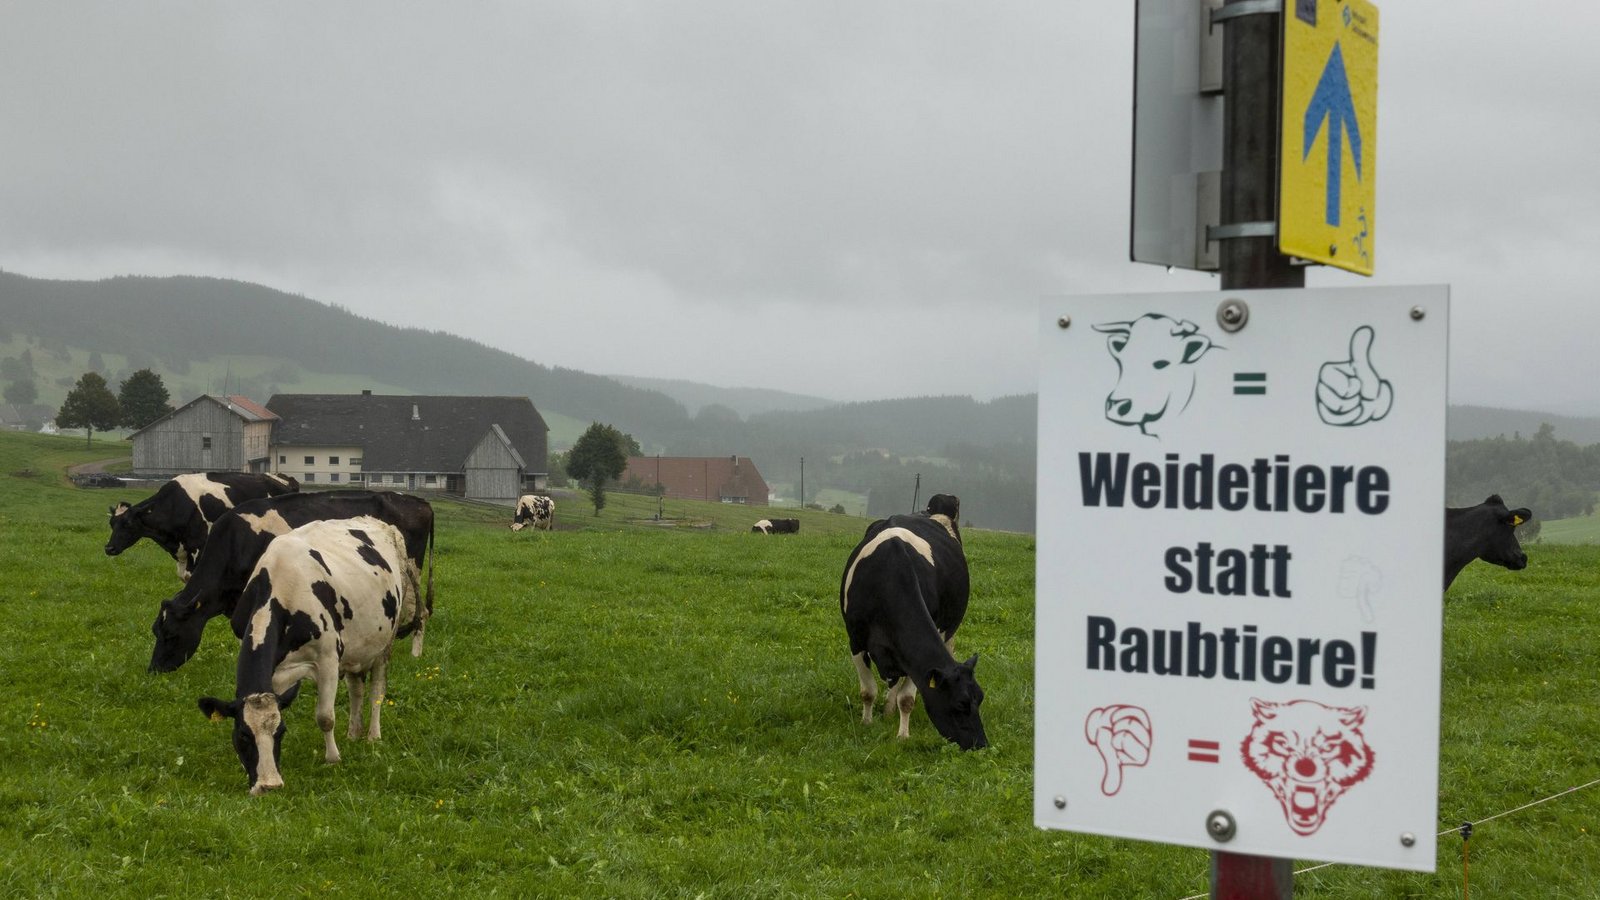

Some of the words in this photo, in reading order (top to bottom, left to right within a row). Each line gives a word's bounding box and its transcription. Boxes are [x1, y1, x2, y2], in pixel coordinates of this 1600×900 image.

[1078, 452, 1390, 515] Weidetiere
[1164, 542, 1292, 598] statt
[1086, 615, 1377, 690] Raubtiere!
